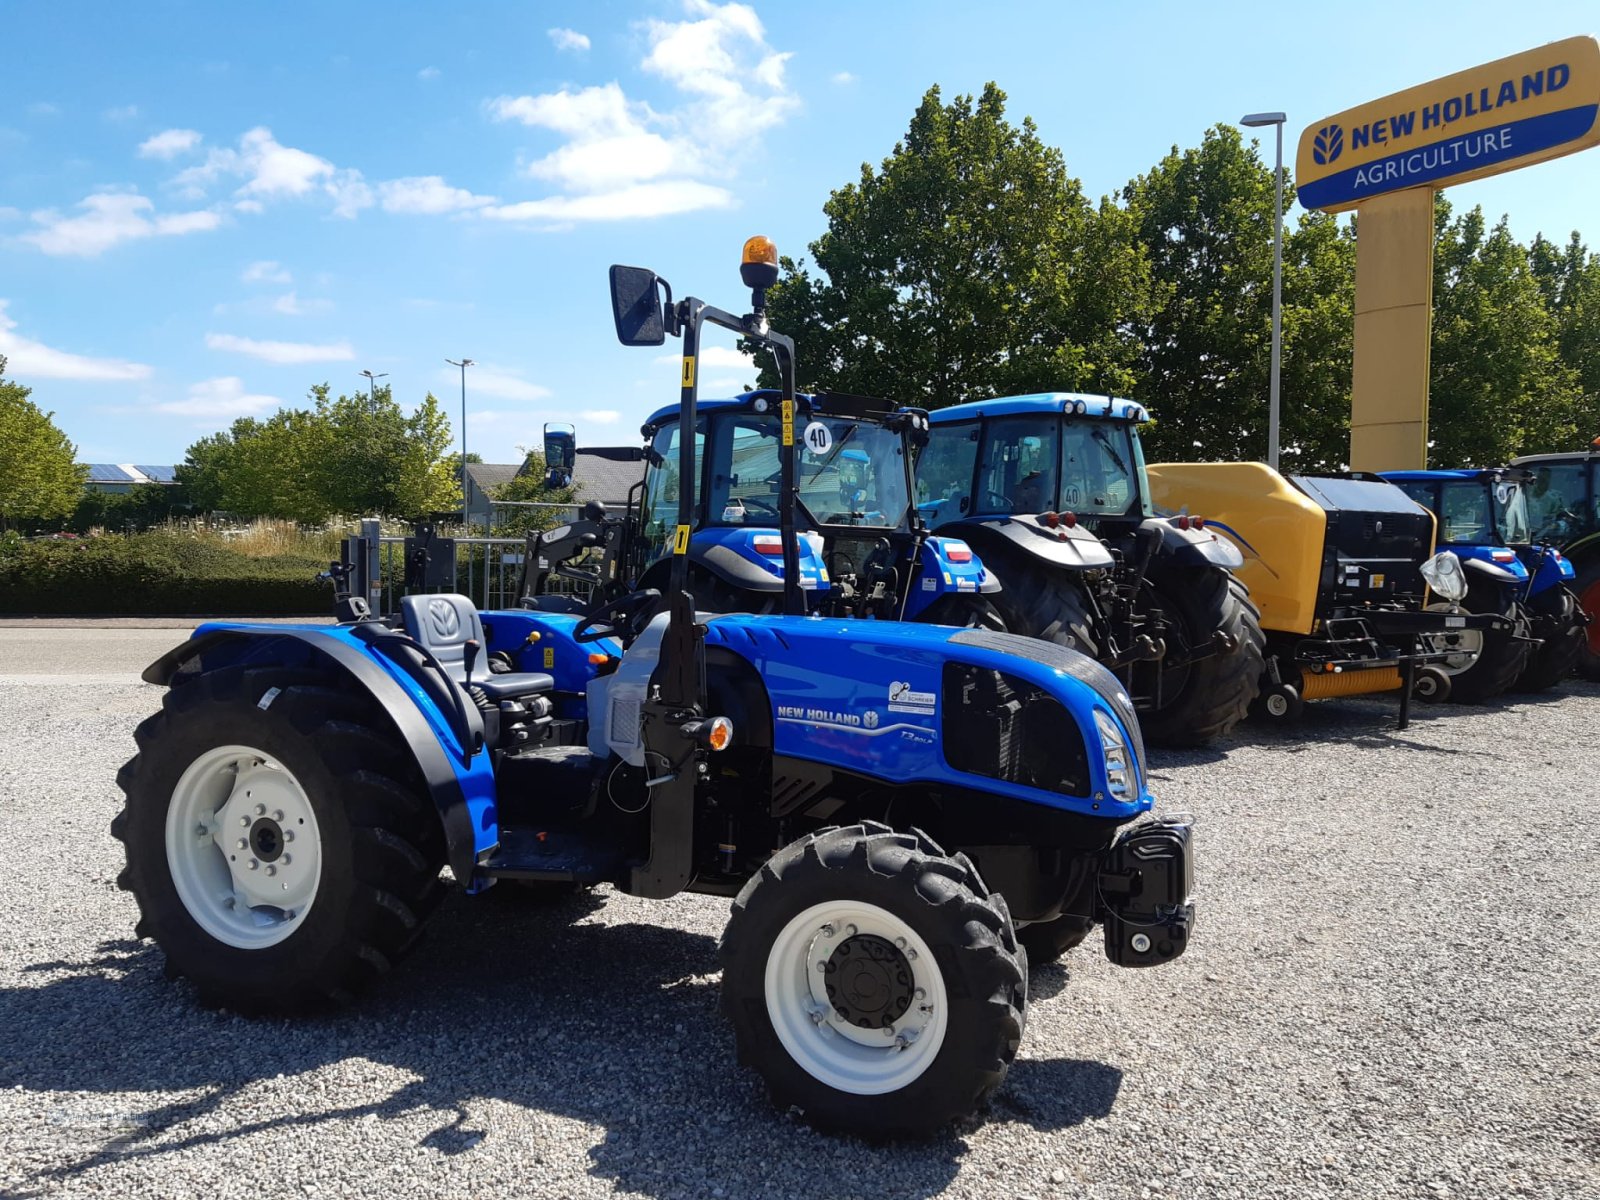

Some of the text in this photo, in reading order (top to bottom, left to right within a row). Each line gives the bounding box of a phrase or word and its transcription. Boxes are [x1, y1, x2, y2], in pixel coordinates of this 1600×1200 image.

[1352, 64, 1570, 150] NEW HOLLAND
[1354, 128, 1512, 188] AGRICULTURE
[810, 428, 826, 448] 40
[1066, 489, 1078, 505] 40
[778, 706, 860, 726] NEW HOLLAND
